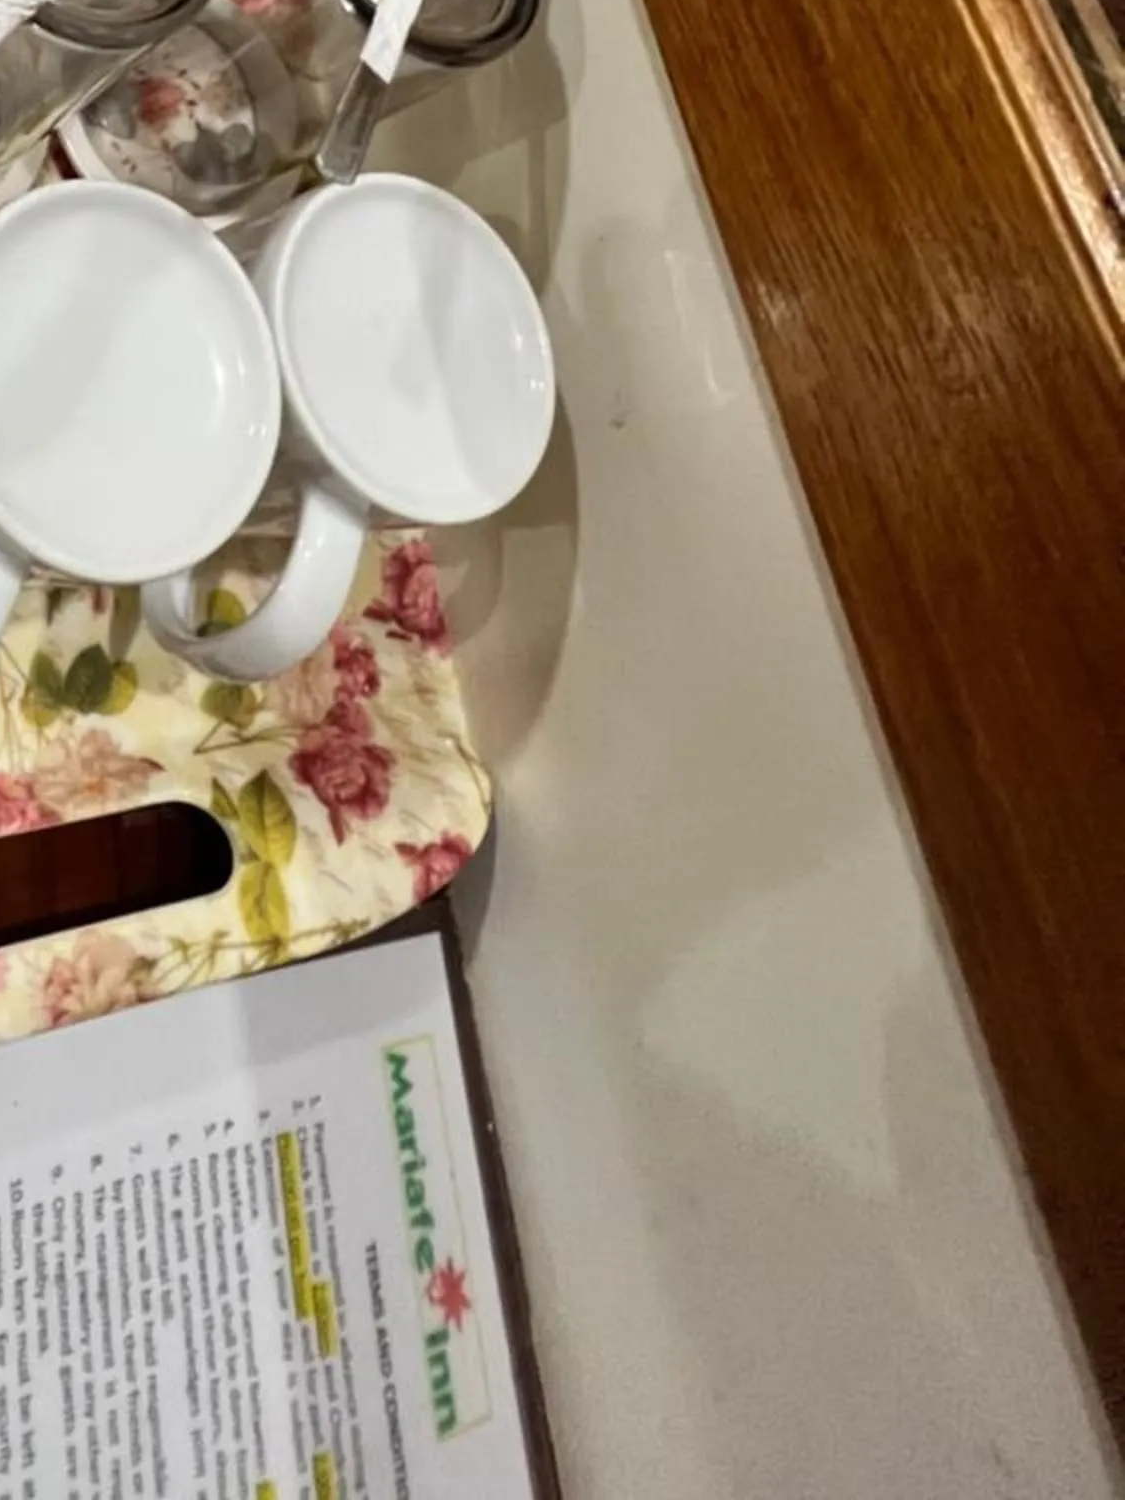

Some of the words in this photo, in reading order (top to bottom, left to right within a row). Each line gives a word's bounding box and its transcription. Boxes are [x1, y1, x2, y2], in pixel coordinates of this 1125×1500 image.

[92, 1186, 106, 1221] The
[131, 1173, 148, 1239] Guests
[169, 1163, 183, 1198] The
[188, 1158, 205, 1217] rooms
[206, 1153, 223, 1207] Room
[224, 1147, 245, 1234] Breakfast
[31, 1203, 45, 1236] the
[49, 1196, 67, 1242] Only
[171, 1208, 189, 1261] guest
[384, 1052, 440, 1274] Mariafe
[424, 1328, 465, 1437] Inn
[31, 1242, 48, 1299] lobby
[136, 1246, 151, 1281] will
[193, 1223, 213, 1310] between
[209, 1214, 231, 1295] cleaning
[233, 1241, 249, 1273] will
[11, 1277, 28, 1323] keys
[52, 1252, 73, 1355] registered
[93, 1233, 114, 1368] management
[220, 1303, 236, 1348] shall
[363, 1241, 387, 1319] TERMS
[375, 1327, 395, 1377] AND
[15, 1331, 31, 1385] must
[121, 1334, 138, 1382] their
[141, 1321, 157, 1365] held
[201, 1316, 218, 1371] these
[57, 1365, 76, 1436] guests
[80, 1381, 96, 1418] any
[227, 1388, 245, 1440] done
[19, 1430, 35, 1468] left
[105, 1409, 120, 1445] not
[125, 1389, 144, 1467] friends
[64, 1445, 77, 1478] are
[84, 1425, 101, 1484] other
